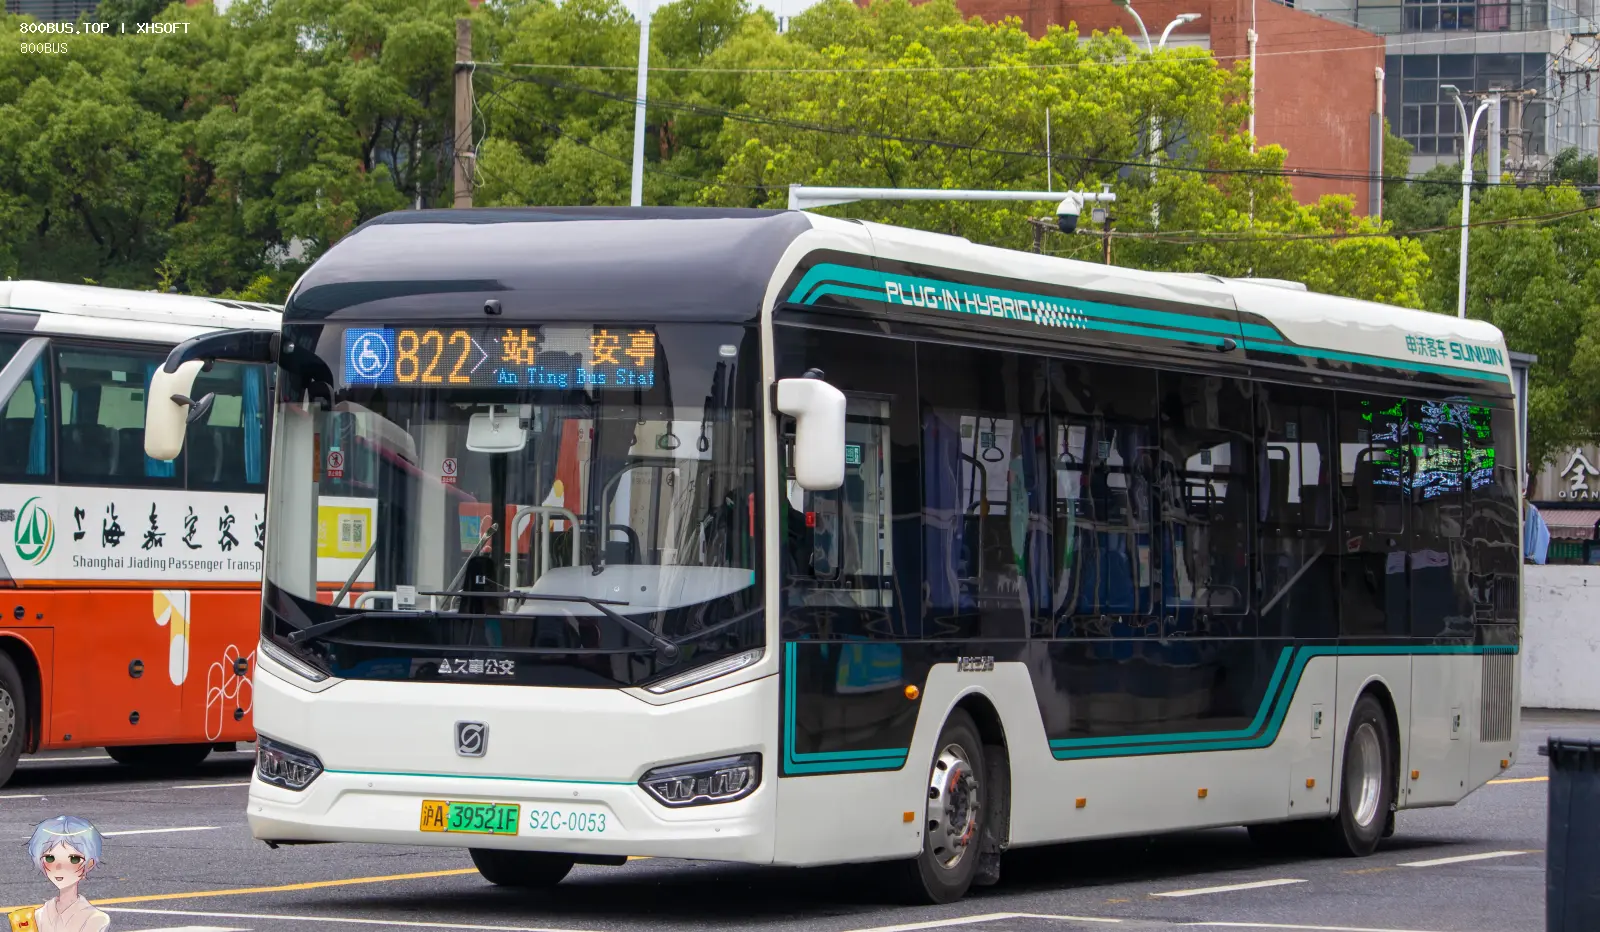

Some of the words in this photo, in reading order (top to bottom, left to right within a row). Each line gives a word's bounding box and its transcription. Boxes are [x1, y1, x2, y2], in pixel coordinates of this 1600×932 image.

[884, 281, 961, 312] PLUG-IN
[963, 291, 1033, 322] HYBRID
[395, 329, 472, 384] 822
[501, 328, 536, 366] 站
[588, 329, 656, 367] 安亭
[1404, 334, 1449, 359] 申沃客车
[1448, 341, 1505, 367] SUNWIN
[497, 368, 519, 385] An
[527, 366, 568, 387] Ting
[576, 368, 607, 385] Bus
[73, 555, 124, 571] Shanghai
[127, 556, 167, 572] Jiading
[168, 557, 223, 573] Passenger
[227, 558, 262, 573] Transp
[529, 809, 607, 833] S2C-0053
